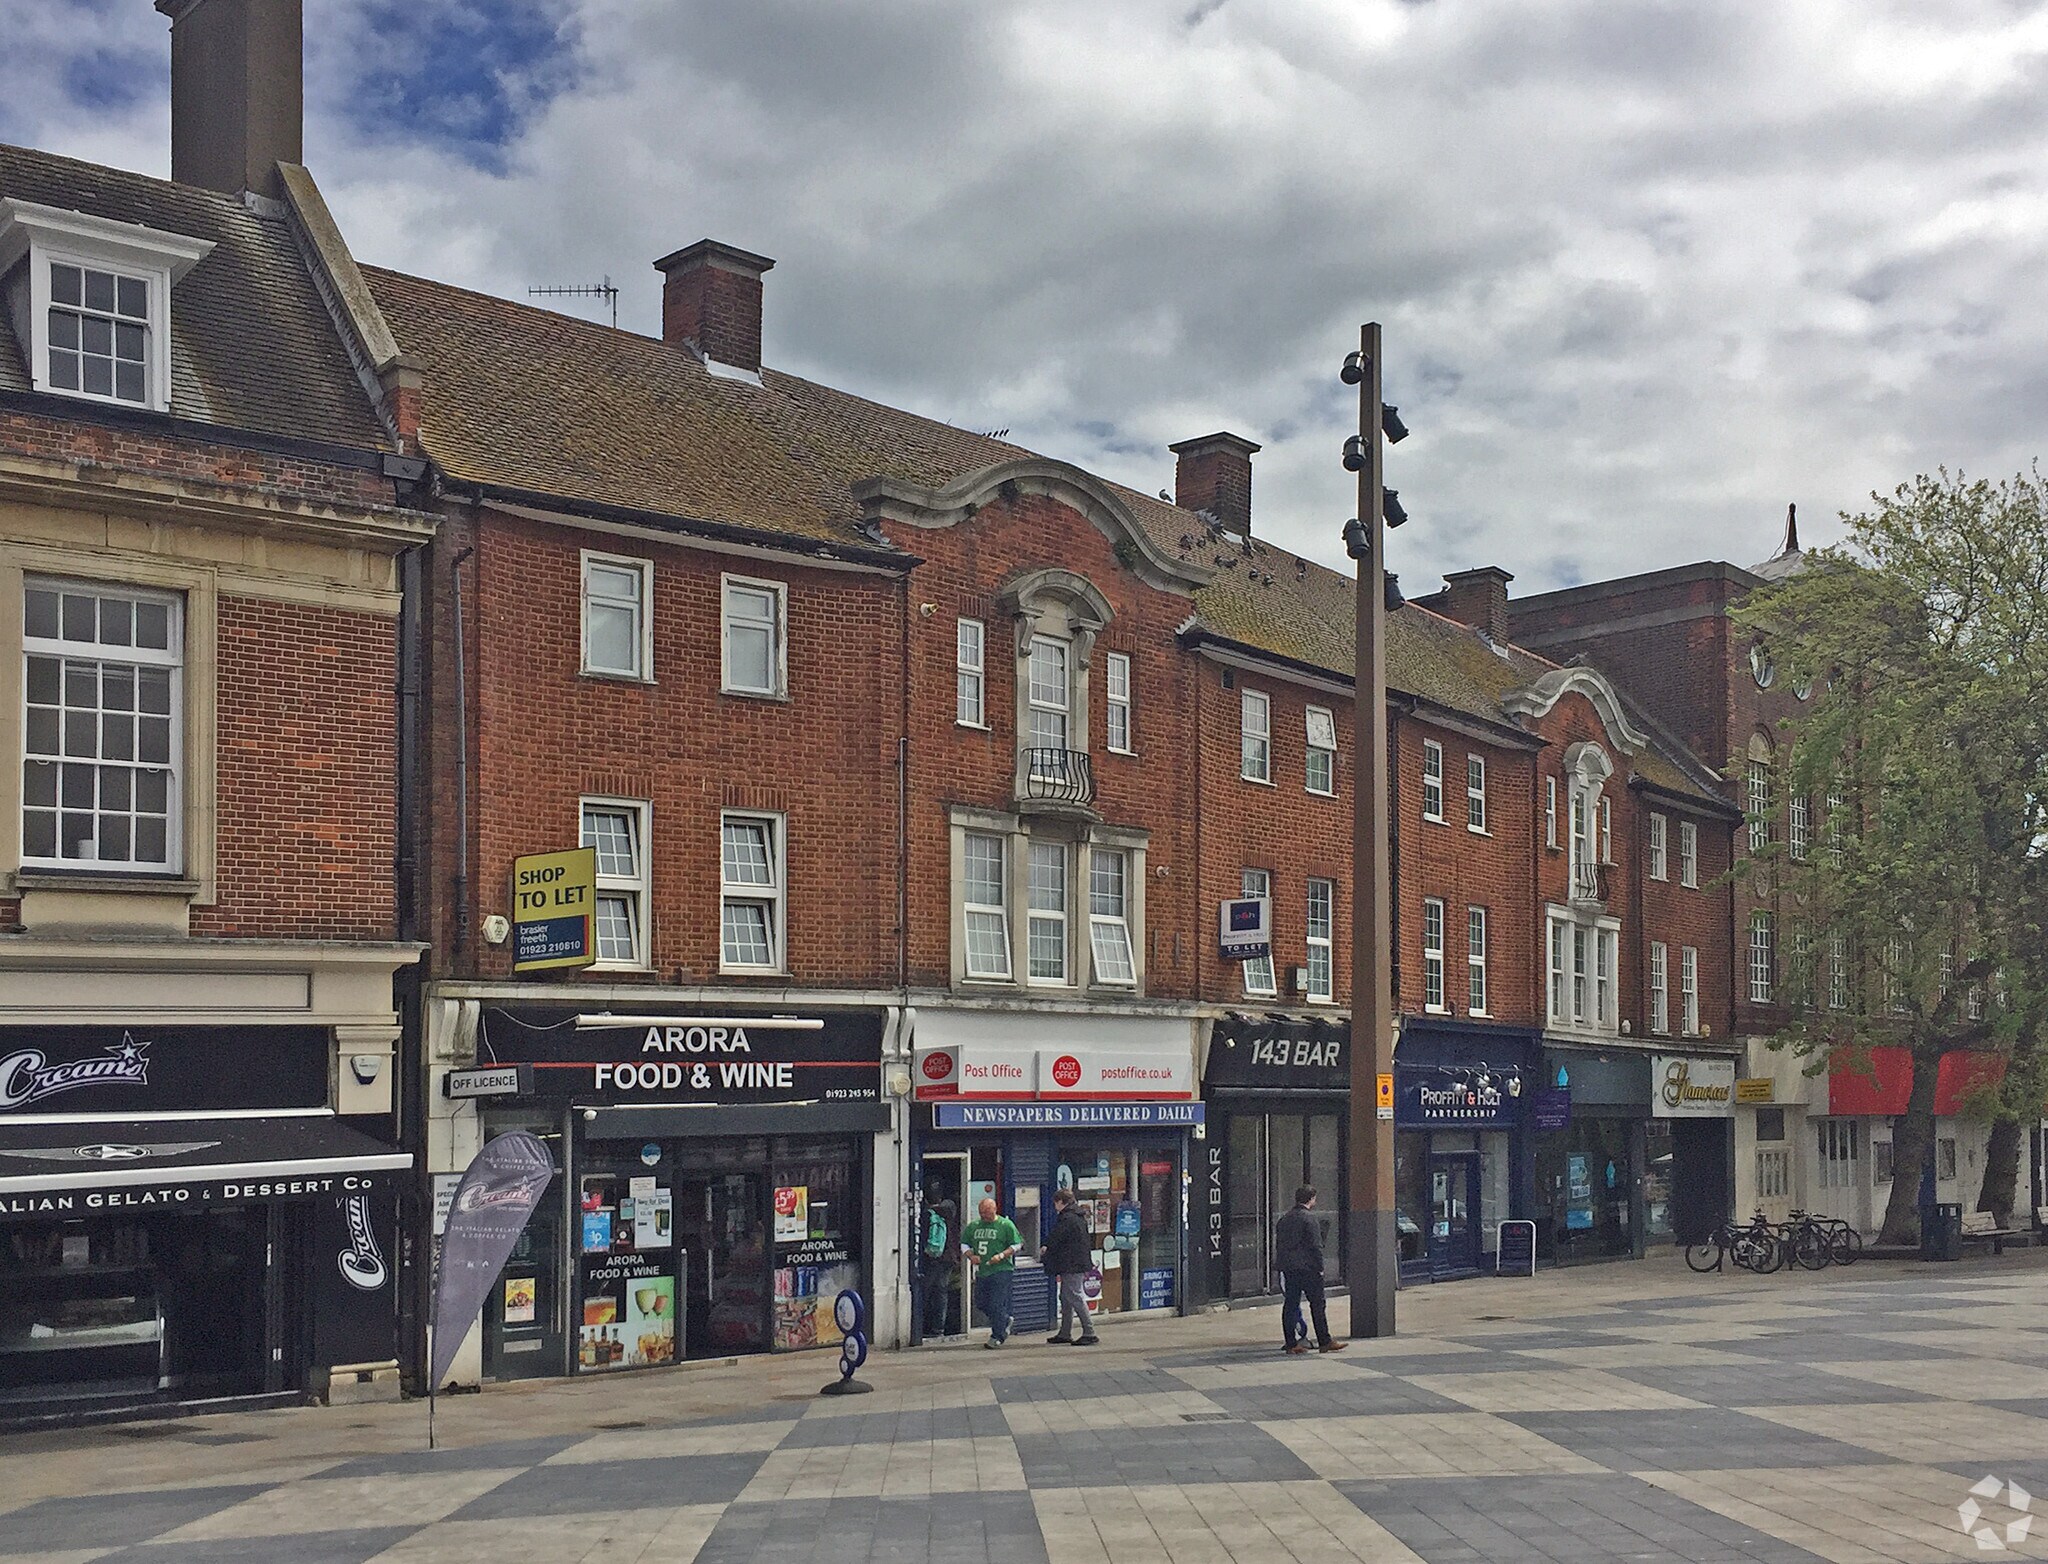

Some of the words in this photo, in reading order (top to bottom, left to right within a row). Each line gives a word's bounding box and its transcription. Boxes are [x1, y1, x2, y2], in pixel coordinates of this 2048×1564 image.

[519, 866, 566, 886] SHOP
[519, 890, 547, 910] TO
[554, 885, 588, 906] LET
[519, 924, 549, 936] brasier
[520, 933, 548, 945] freeth
[519, 944, 547, 956] 01923
[549, 939, 581, 953] 210810
[641, 1026, 751, 1053] ARORA
[1251, 1038, 1291, 1065] 143
[1293, 1040, 1341, 1066] BAR
[928, 1056, 948, 1066] POST
[1058, 1061, 1076, 1070] POST
[595, 1062, 682, 1090] FOOD
[690, 1062, 712, 1089] &
[719, 1062, 794, 1088] WINE
[924, 1064, 950, 1074] OFFICE
[964, 1063, 989, 1078] Post
[991, 1063, 1023, 1078] Office
[1054, 1070, 1079, 1080] OFFICE
[1101, 1066, 1173, 1081] postoffice.co.uk
[452, 1078, 472, 1090] OFF
[474, 1075, 516, 1088] LICENCE
[825, 1089, 848, 1098] 01923
[1467, 1091, 1476, 1105] &
[963, 1107, 1063, 1123] NEWSPAPERS
[1069, 1106, 1151, 1122] DELIVERED
[1157, 1105, 1195, 1120] DAILY
[1425, 1108, 1497, 1118] PARTNERSHIP
[1209, 1147, 1221, 1205] BAR
[86, 1188, 190, 1208] GELATO
[202, 1189, 211, 1199] &
[223, 1179, 333, 1198] DESSERT
[973, 1228, 999, 1240] CELTICS
[1209, 1212, 1222, 1259] 143
[801, 1240, 835, 1251] ARORA
[977, 1240, 989, 1256] 5
[606, 1254, 645, 1266] ARORA
[786, 1253, 814, 1263] FOOD
[815, 1252, 823, 1261] &
[824, 1251, 848, 1261] WINE
[589, 1268, 621, 1280] FOOD
[622, 1268, 631, 1277] &
[632, 1266, 661, 1276] WINE
